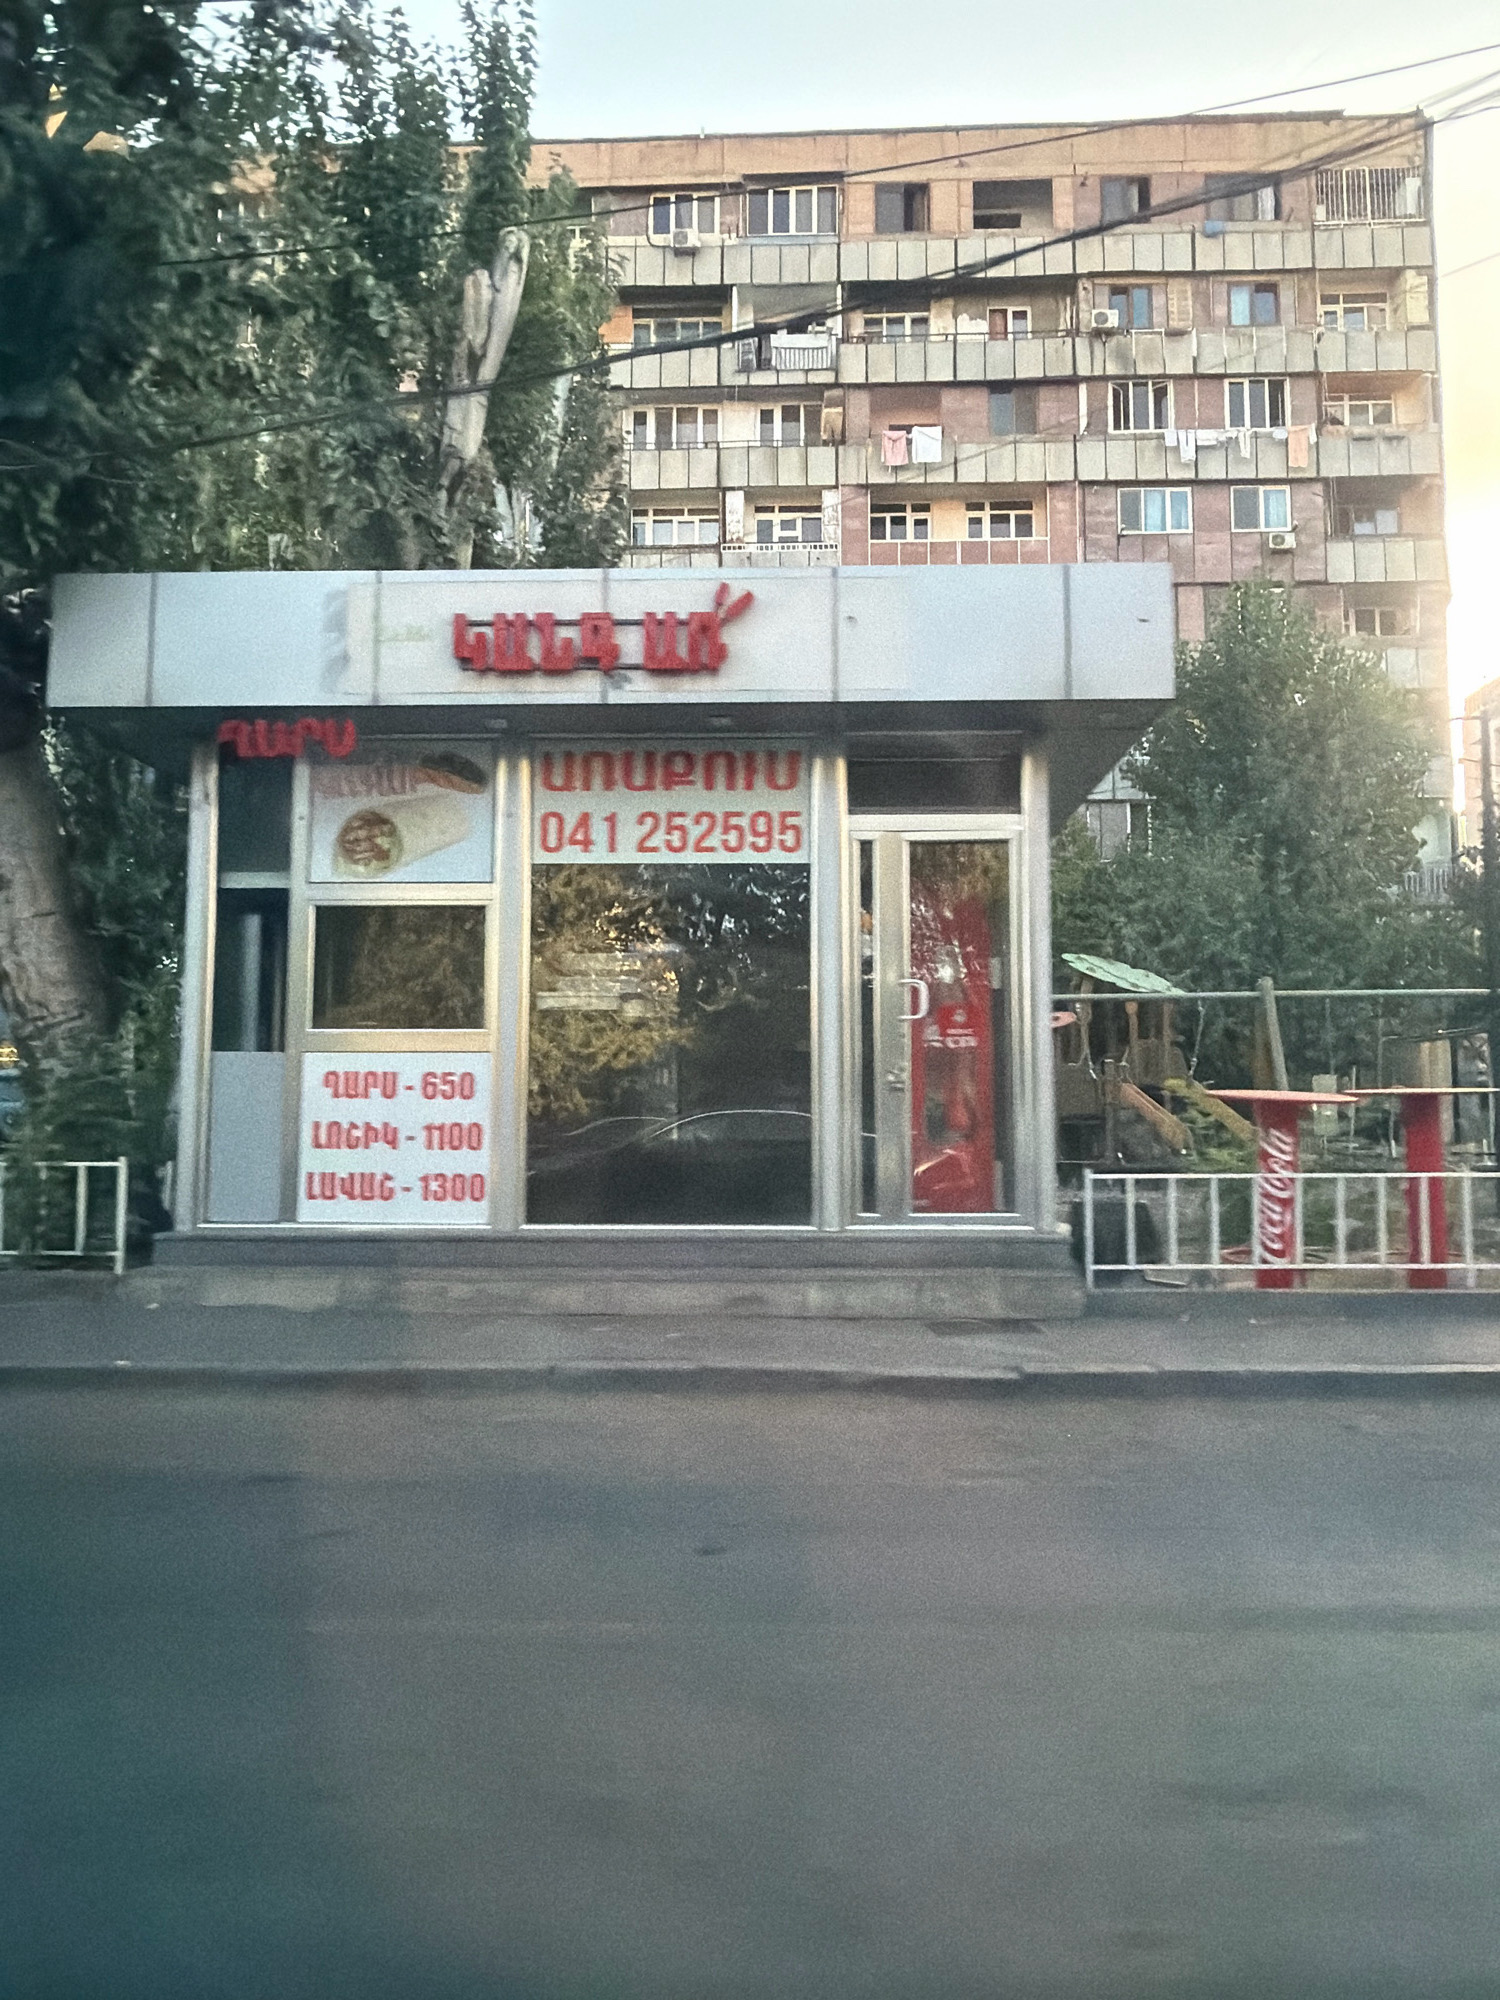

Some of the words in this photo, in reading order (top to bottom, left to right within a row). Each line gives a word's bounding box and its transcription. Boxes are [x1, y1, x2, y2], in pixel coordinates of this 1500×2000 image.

[453, 612, 620, 671] ԿԱՆԳ
[540, 811, 618, 854] 041
[636, 811, 803, 854] 252595
[422, 1072, 475, 1100] 650
[312, 1121, 398, 1150] ԼՈՇԻԿ
[423, 1122, 483, 1150] 1100
[306, 1172, 395, 1201] ԼԱՎԱՇ
[419, 1173, 485, 1201] 1300
